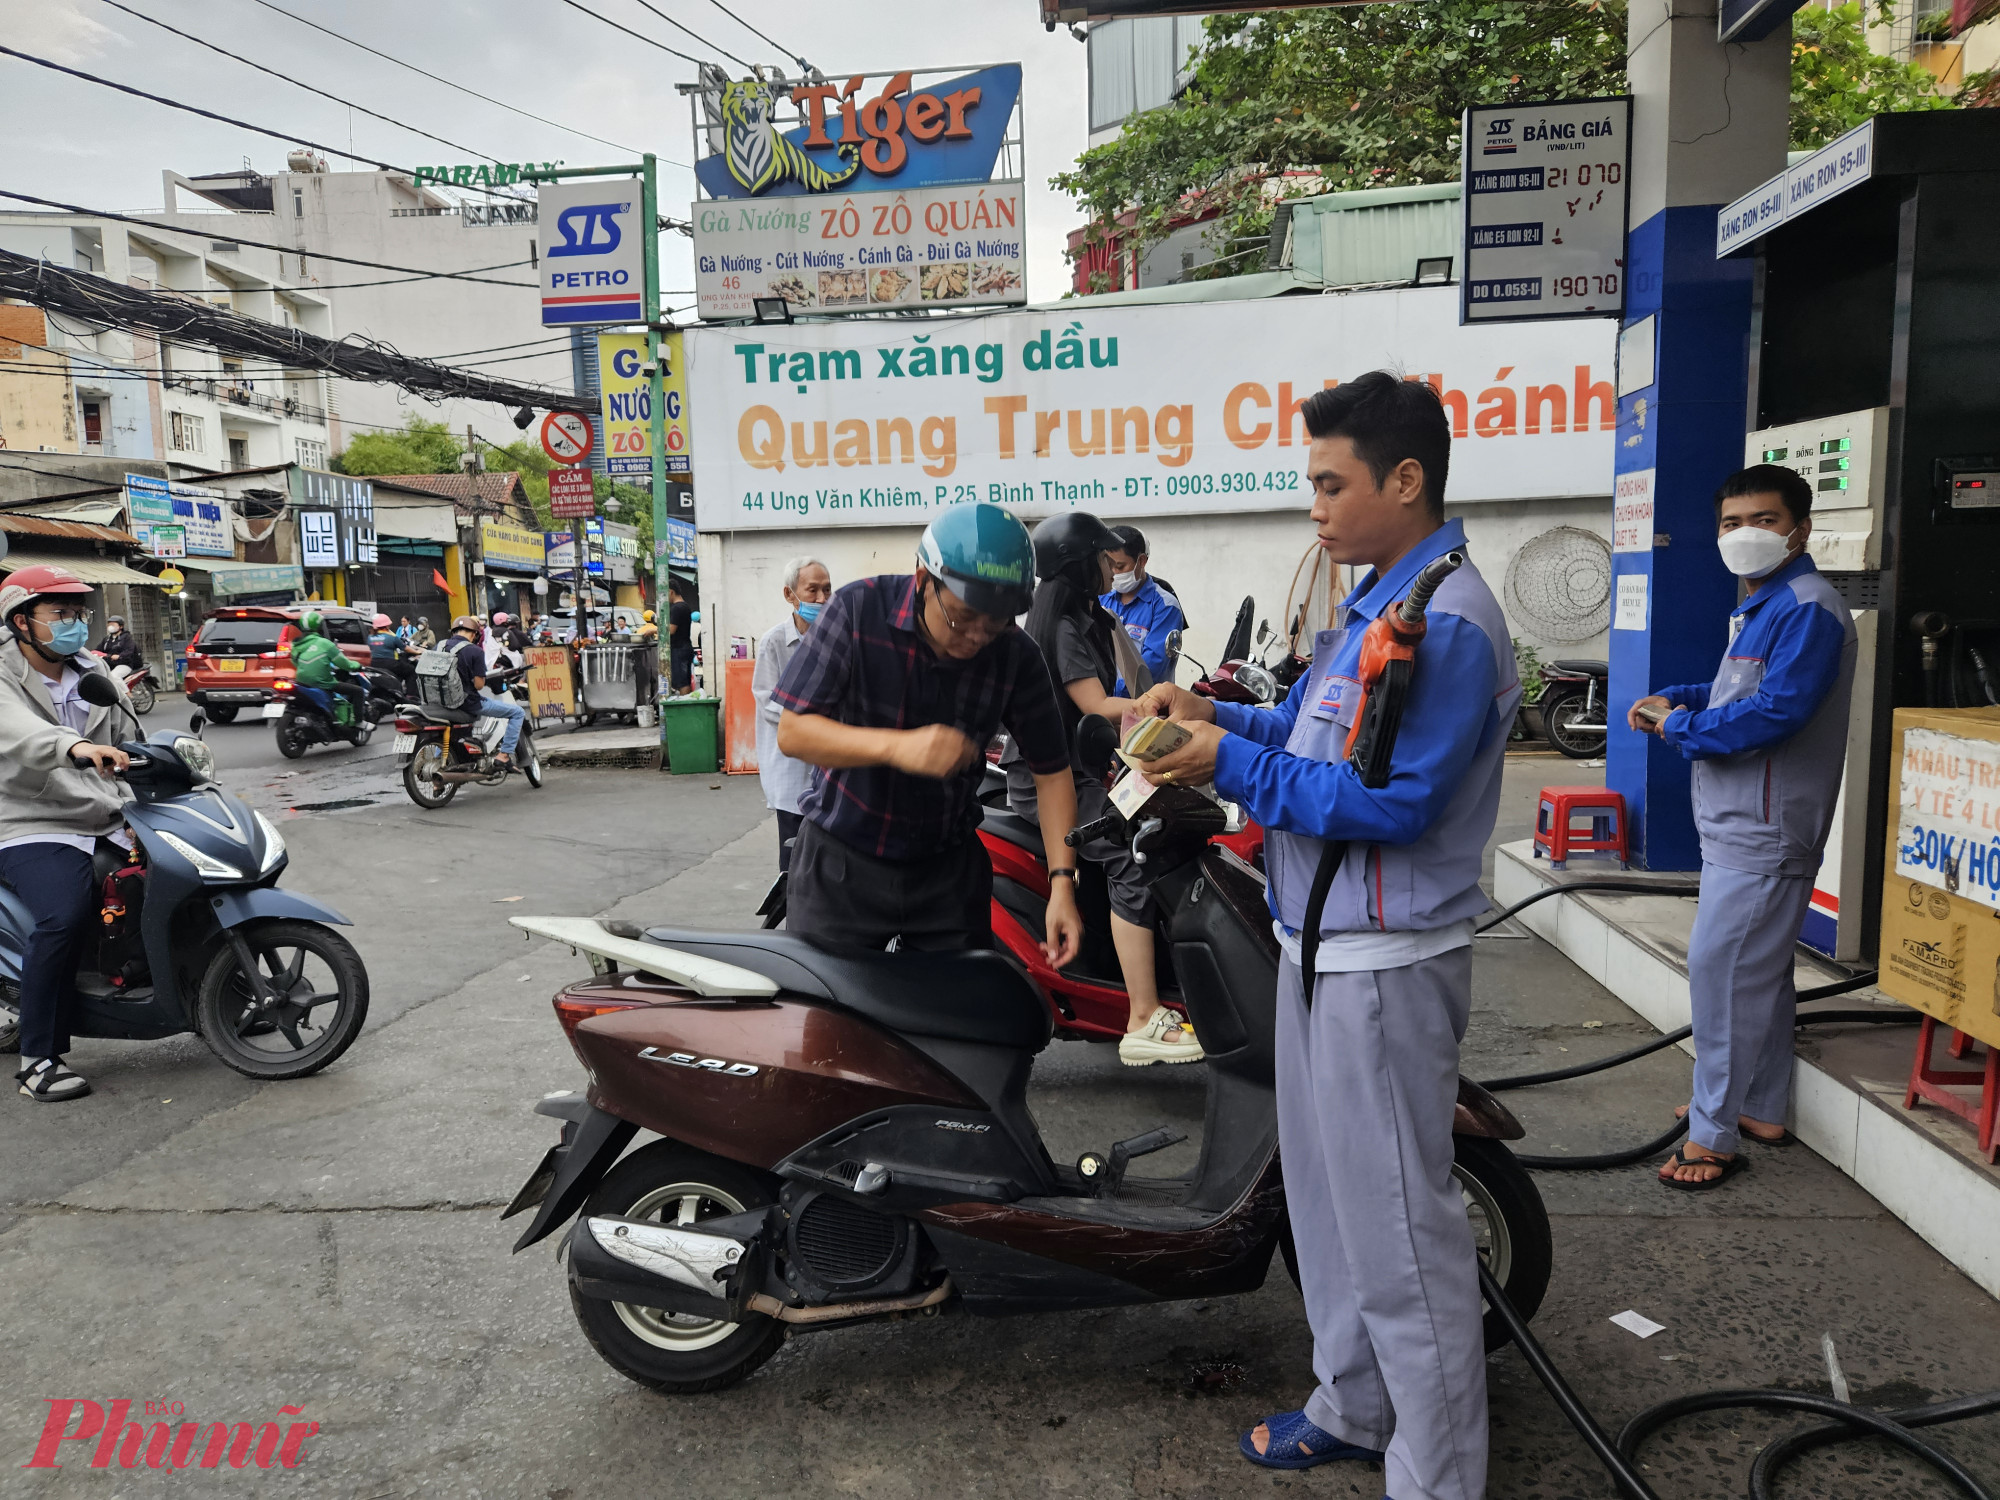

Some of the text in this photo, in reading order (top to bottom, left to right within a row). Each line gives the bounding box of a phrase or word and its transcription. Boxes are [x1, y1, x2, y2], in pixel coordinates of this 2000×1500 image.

[1523, 117, 1613, 142] BẢNG GIÁ
[1817, 160, 1837, 189] RON
[1840, 143, 1866, 176] 95-III
[1475, 173, 1540, 190] XĂNG RON 95-III
[700, 190, 1016, 239] Gà Nướng ZÔ ZÔ QUÁN
[1742, 205, 1758, 231] RON
[1761, 192, 1781, 221] 95-III
[1473, 228, 1539, 245] XĂNG E5 RON 92-II
[700, 254, 716, 273] Gà
[721, 252, 762, 274] Nướng
[776, 251, 798, 270] Cút
[803, 248, 844, 270] Nướng
[858, 246, 891, 265] Cánh
[896, 244, 913, 262] Gà
[927, 241, 950, 260] Đùi
[954, 239, 972, 259] Gà
[976, 237, 1020, 260] Nướng
[552, 270, 629, 288] PETRO
[722, 276, 740, 290] 46
[1473, 282, 1540, 299] DO 0.05S-II
[734, 321, 1119, 394] Trạm xăng dầu
[612, 426, 645, 453] ZÔ
[737, 403, 957, 478] Quang
[984, 395, 1194, 467] Trung
[558, 470, 583, 483] CẤM
[627, 463, 650, 471] 0902
[670, 462, 687, 470] 558
[742, 491, 764, 511] 44
[771, 490, 809, 515] Ung
[815, 488, 853, 508] Văn
[859, 484, 928, 510] Khiêm,
[989, 480, 1034, 504] Bình
[1040, 478, 1105, 506] Thạnh
[1125, 476, 1158, 497] ĐT:
[1167, 470, 1299, 496] 0903.930.432
[549, 651, 565, 665] HEO
[547, 677, 562, 691] HEO
[1907, 740, 1960, 781] KHẨU
[1914, 786, 1925, 811] Y
[1932, 784, 1959, 819] TẾ
[1961, 798, 1974, 824] 4
[637, 1046, 759, 1077] LEAD
[935, 1119, 990, 1131] PGM-FI
